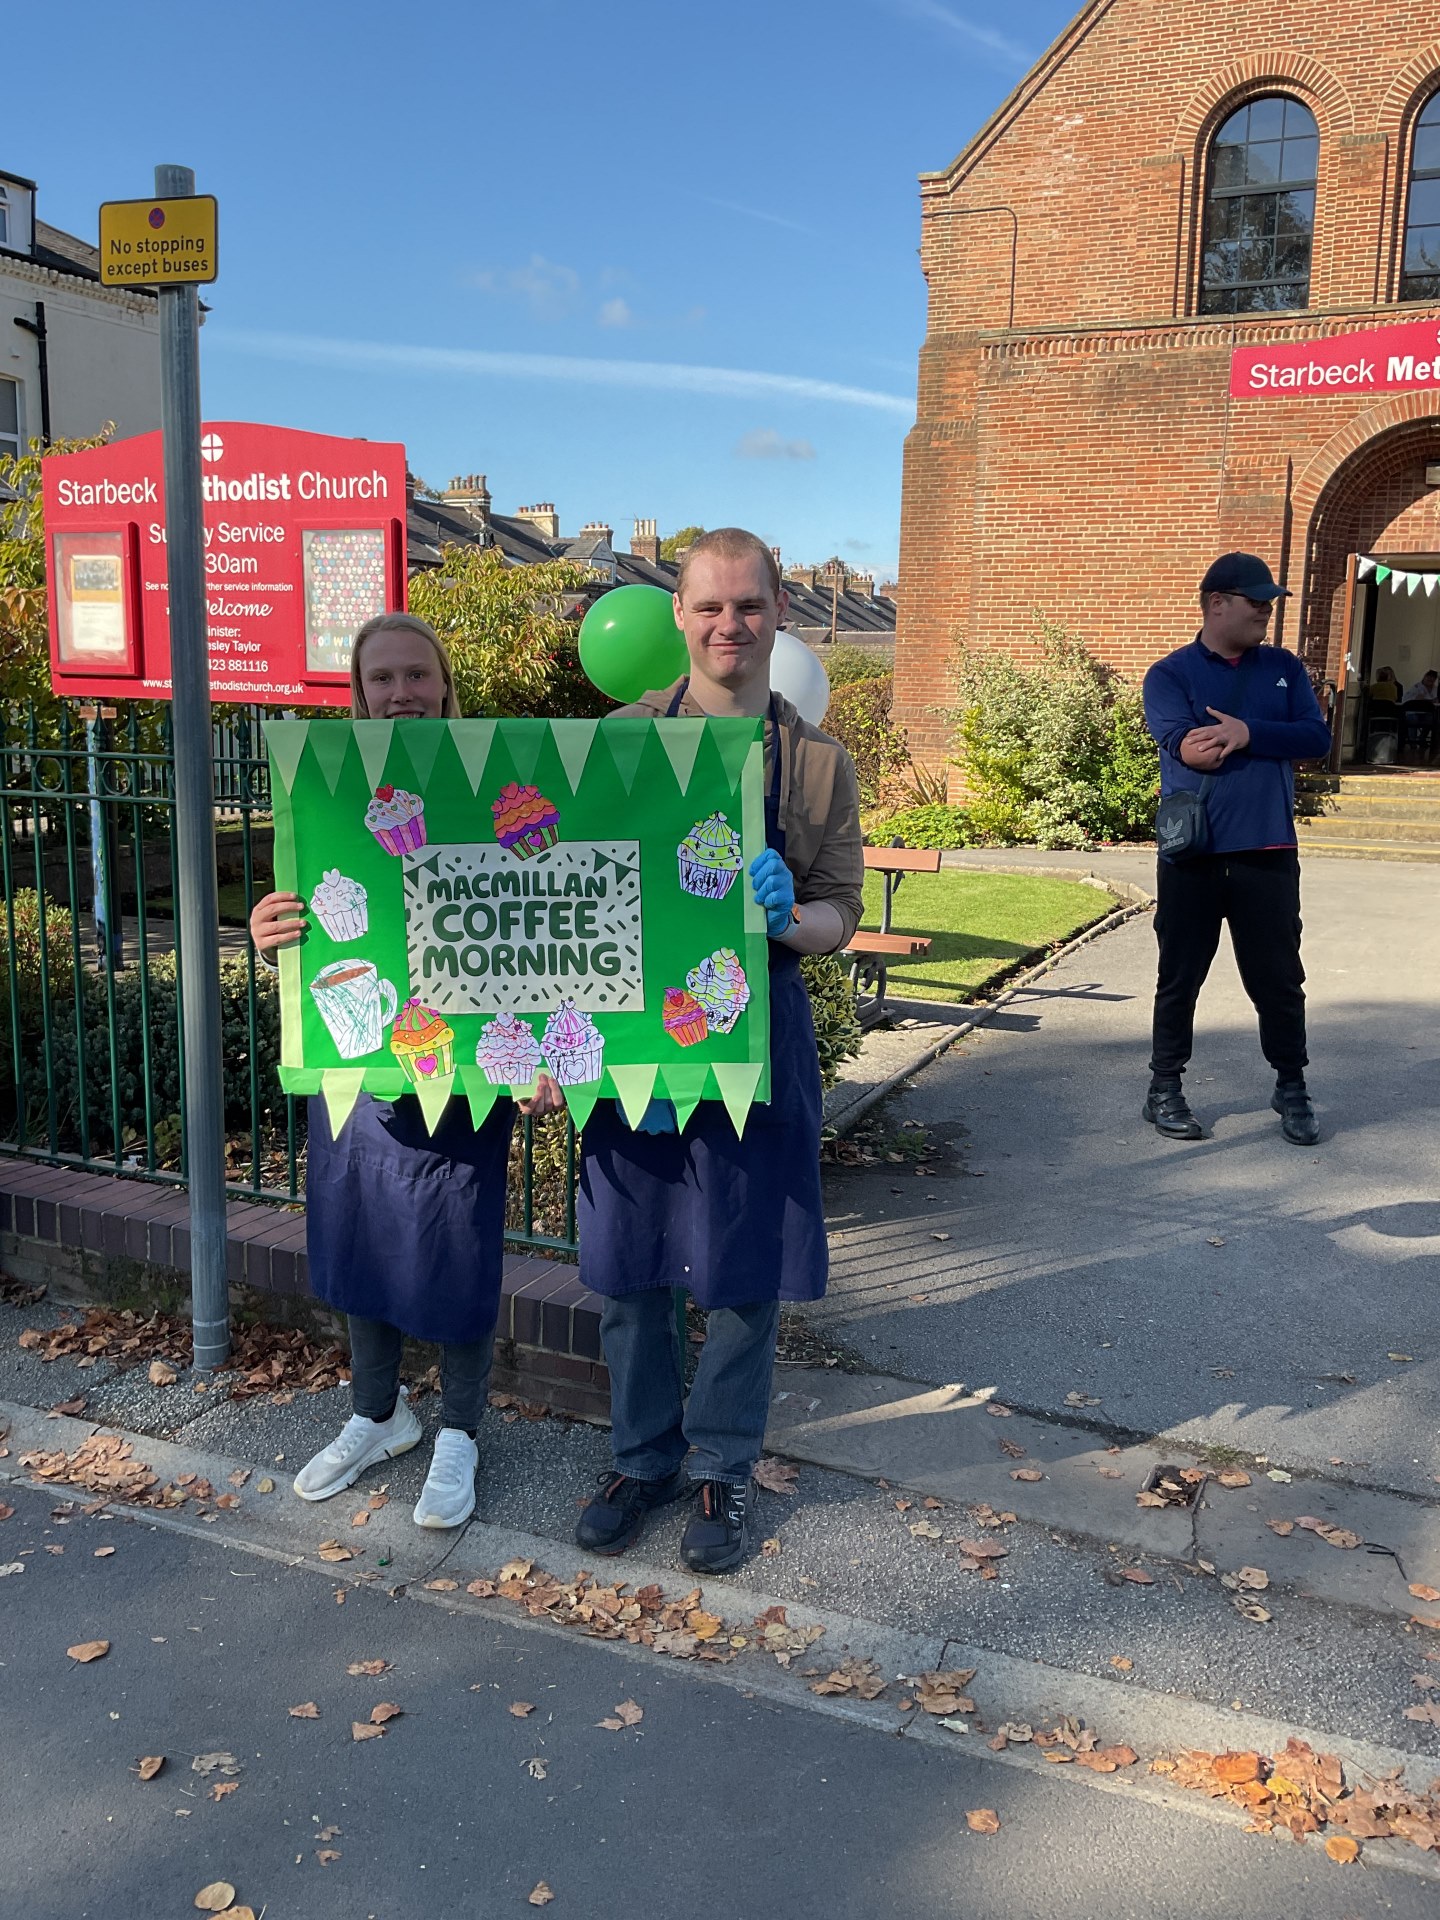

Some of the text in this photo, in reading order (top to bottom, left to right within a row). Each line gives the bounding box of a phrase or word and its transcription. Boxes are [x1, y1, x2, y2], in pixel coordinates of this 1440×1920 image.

[110, 235, 205, 255] No stopping
[107, 257, 208, 277] except buses
[1249, 355, 1440, 389] Starbeck Met
[58, 470, 388, 506] Starbeck thodist Church
[218, 522, 285, 543] Service
[205, 552, 258, 573] 30am
[145, 581, 159, 591] See
[224, 582, 250, 591] service
[251, 582, 293, 591] information
[206, 597, 273, 617] elcome
[207, 625, 241, 637] inister:
[232, 640, 261, 654] Taylor
[228, 659, 268, 673] 881116
[426, 870, 607, 904] MACMILLAN
[432, 900, 600, 942] COFFEE
[422, 941, 622, 978] MORNING
